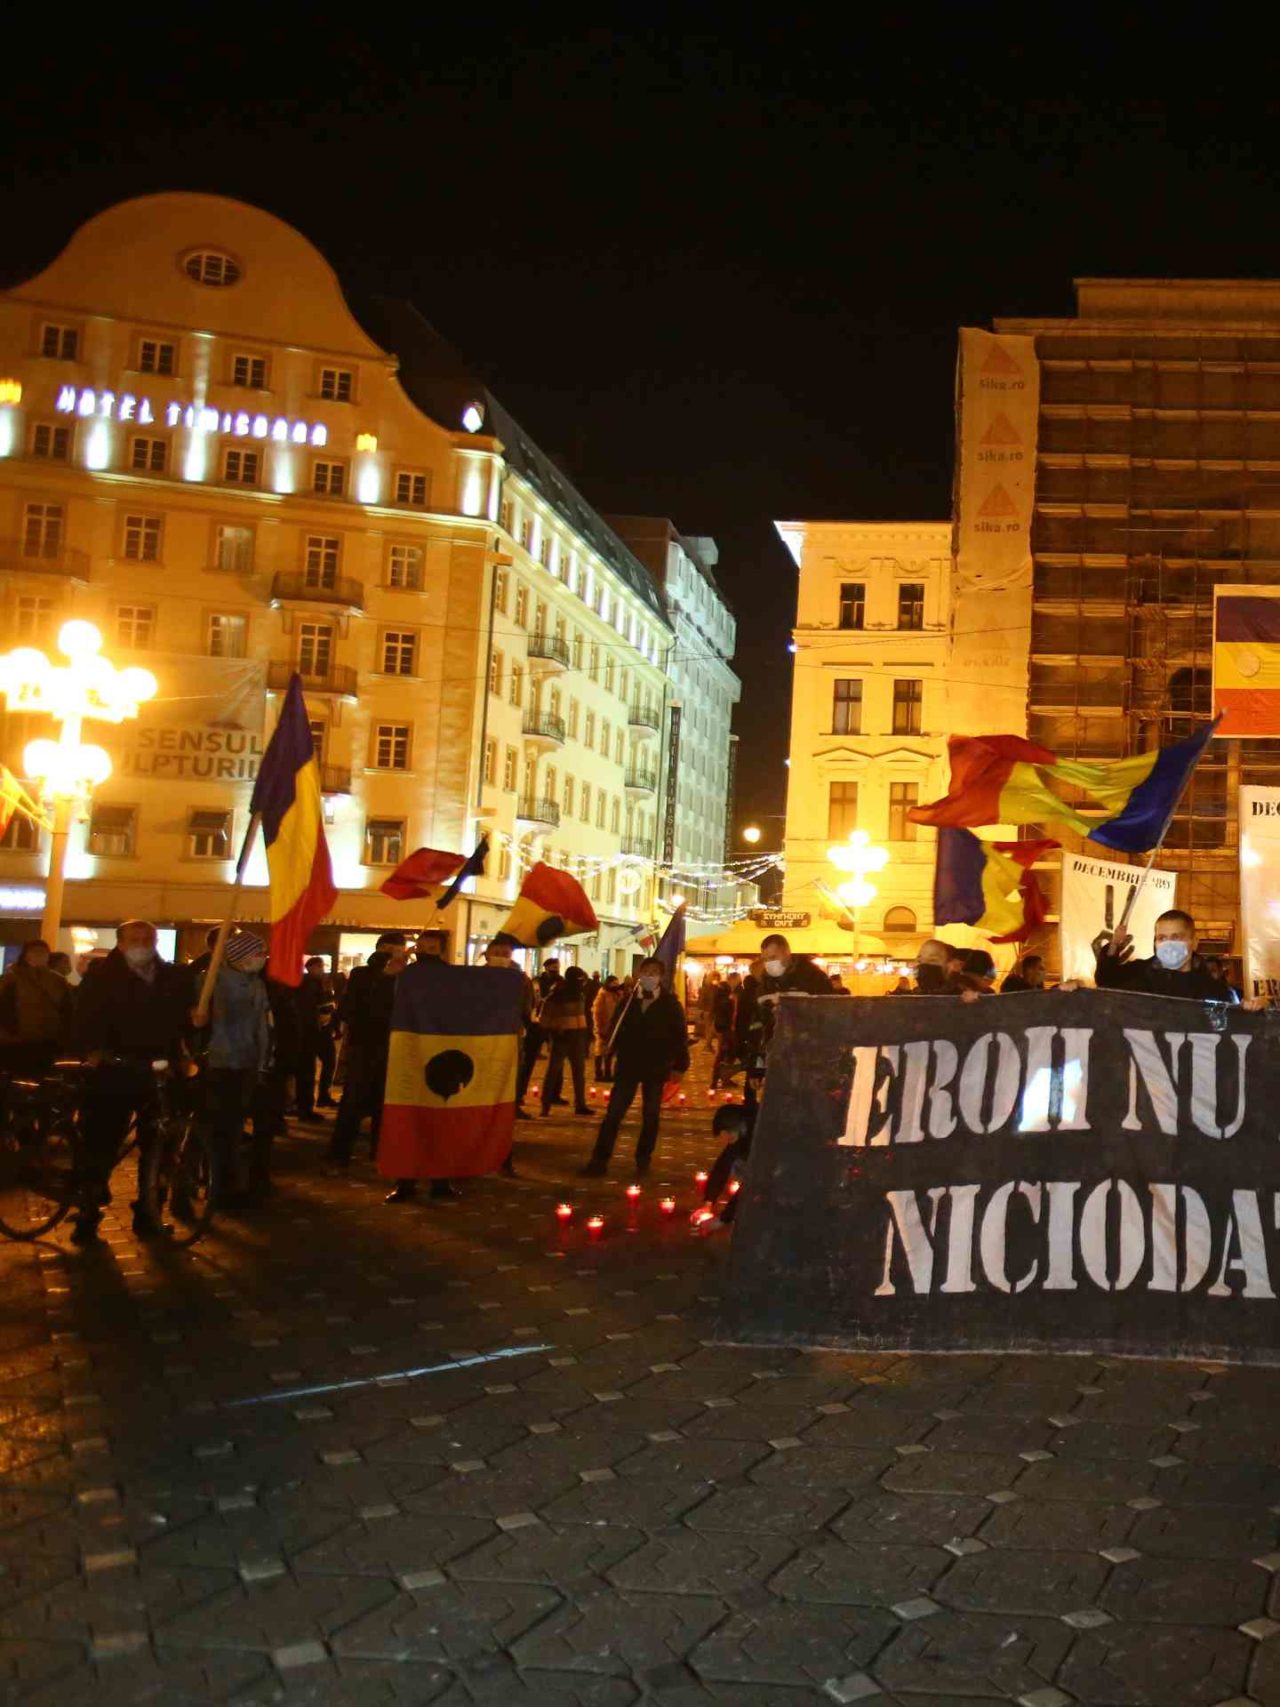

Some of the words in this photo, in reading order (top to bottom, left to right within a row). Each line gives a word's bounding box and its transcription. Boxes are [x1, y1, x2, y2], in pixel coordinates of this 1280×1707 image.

[56, 384, 154, 425] HOTEL
[137, 728, 263, 755] SENSUL
[837, 1026, 1094, 1147] EROII
[1121, 1028, 1253, 1140] NU
